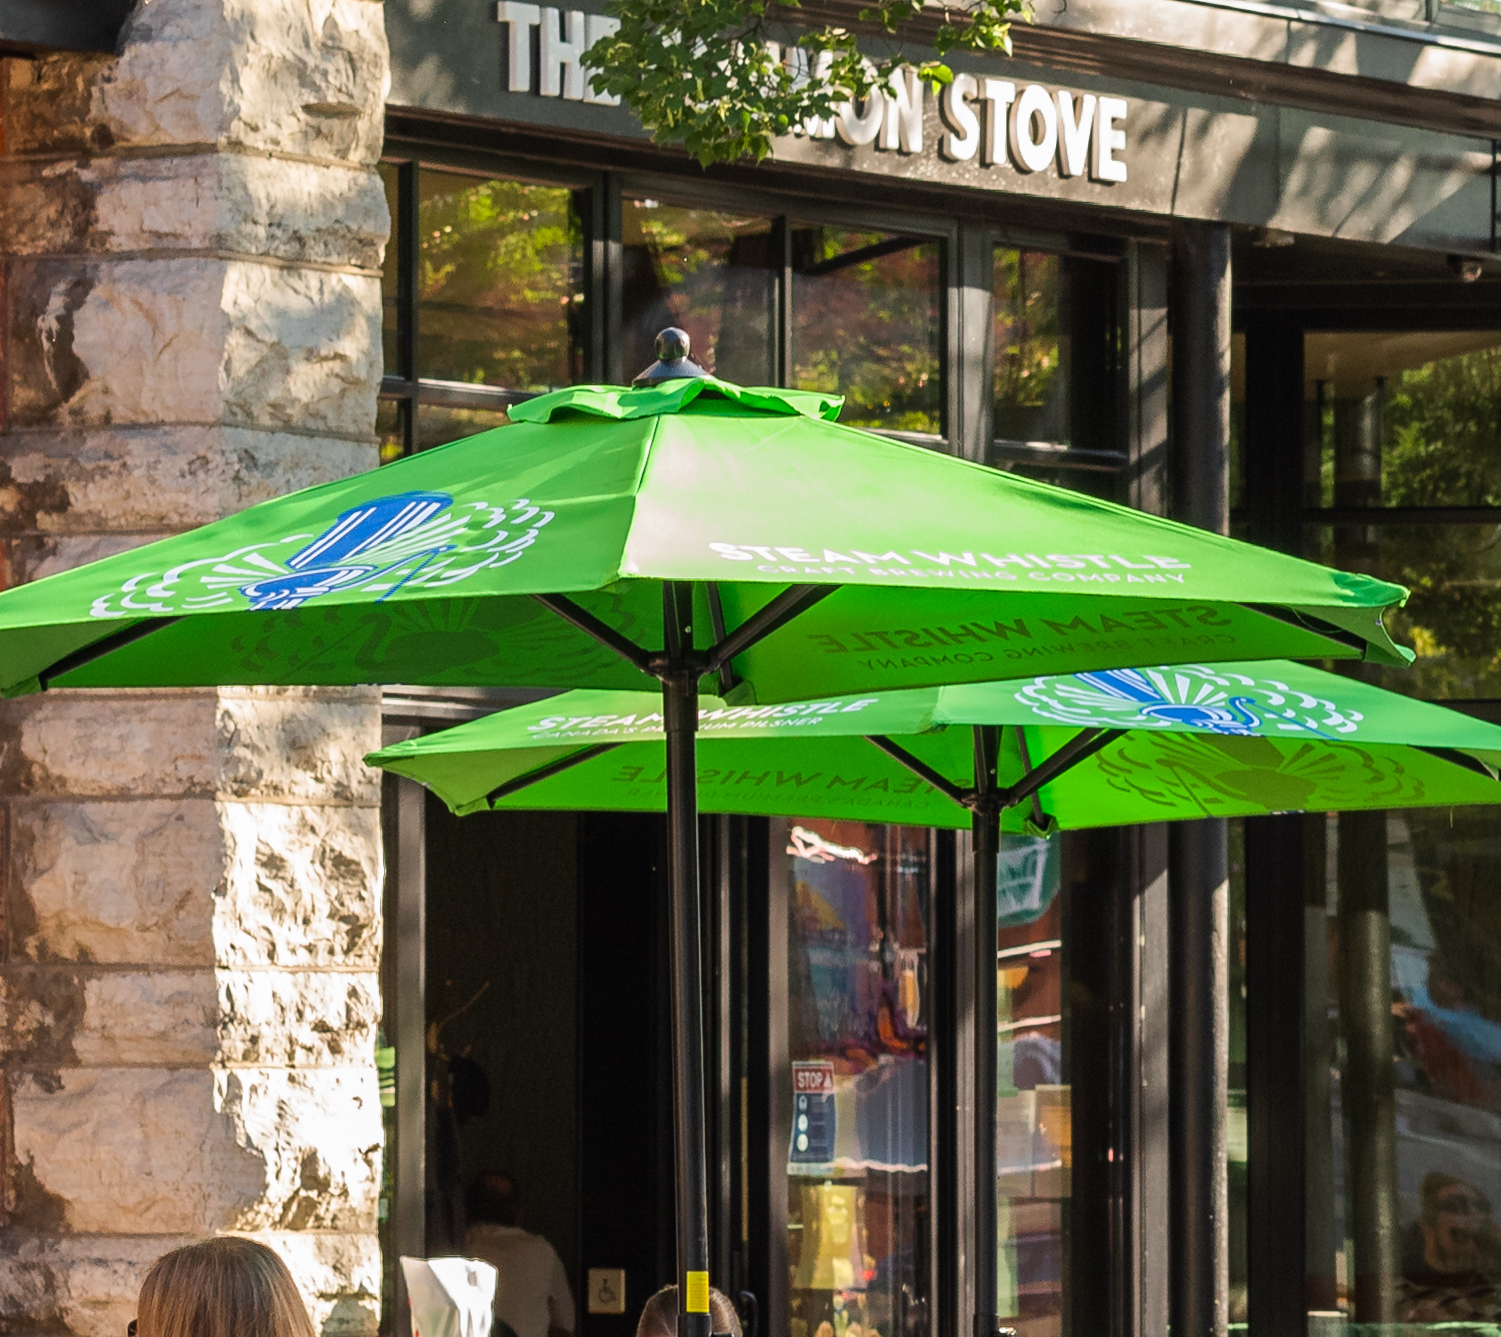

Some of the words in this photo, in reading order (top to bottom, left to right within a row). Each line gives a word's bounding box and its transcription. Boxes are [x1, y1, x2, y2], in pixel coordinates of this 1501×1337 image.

[497, 0, 622, 106] THE
[942, 72, 1129, 183] STOVE
[708, 542, 907, 566] STEAM
[910, 550, 1192, 570] WHISTLE
[756, 565, 855, 577] CRAFT
[870, 567, 1018, 581] BREWING
[1029, 570, 1187, 585] COMPANY
[697, 698, 879, 720] WHISTLE
[739, 716, 824, 730] PILSNER
[798, 1071, 823, 1088] STOP
